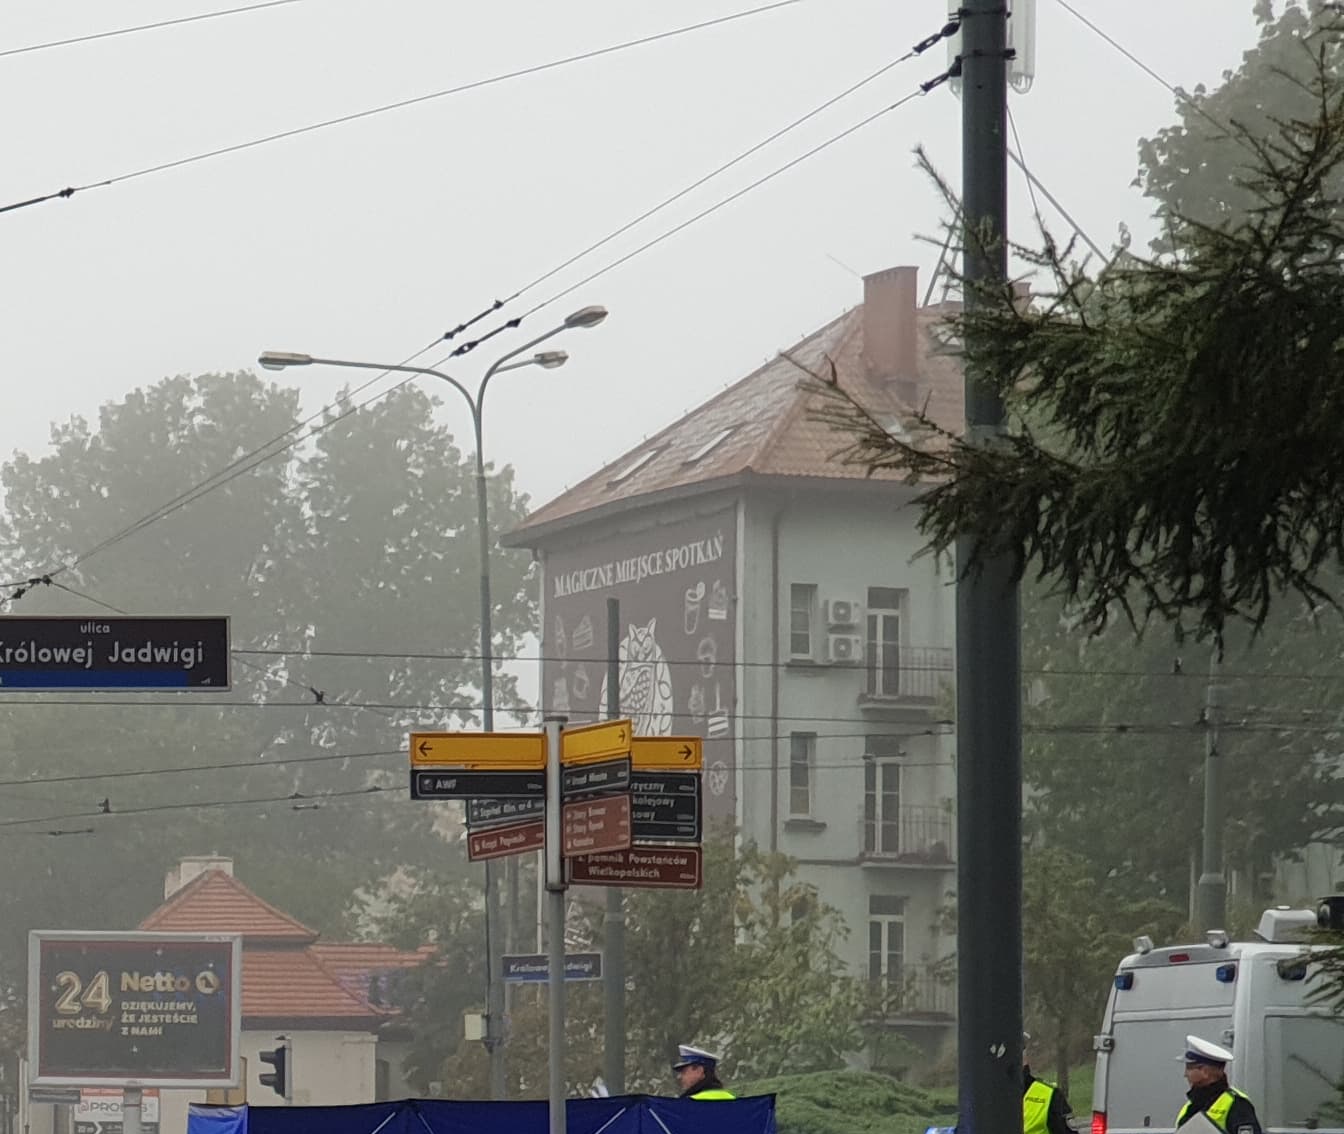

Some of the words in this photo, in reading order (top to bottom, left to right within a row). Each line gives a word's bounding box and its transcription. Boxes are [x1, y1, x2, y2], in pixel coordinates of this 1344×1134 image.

[553, 563, 614, 599] MAGICZNE
[615, 550, 664, 585] MIEJSCE
[80, 622, 111, 633] ulica
[107, 640, 204, 670] Jadwigi
[54, 970, 113, 1015] 24
[120, 971, 191, 993] Netto
[52, 1015, 114, 1032] urodziny
[120, 1026, 129, 1036] Z
